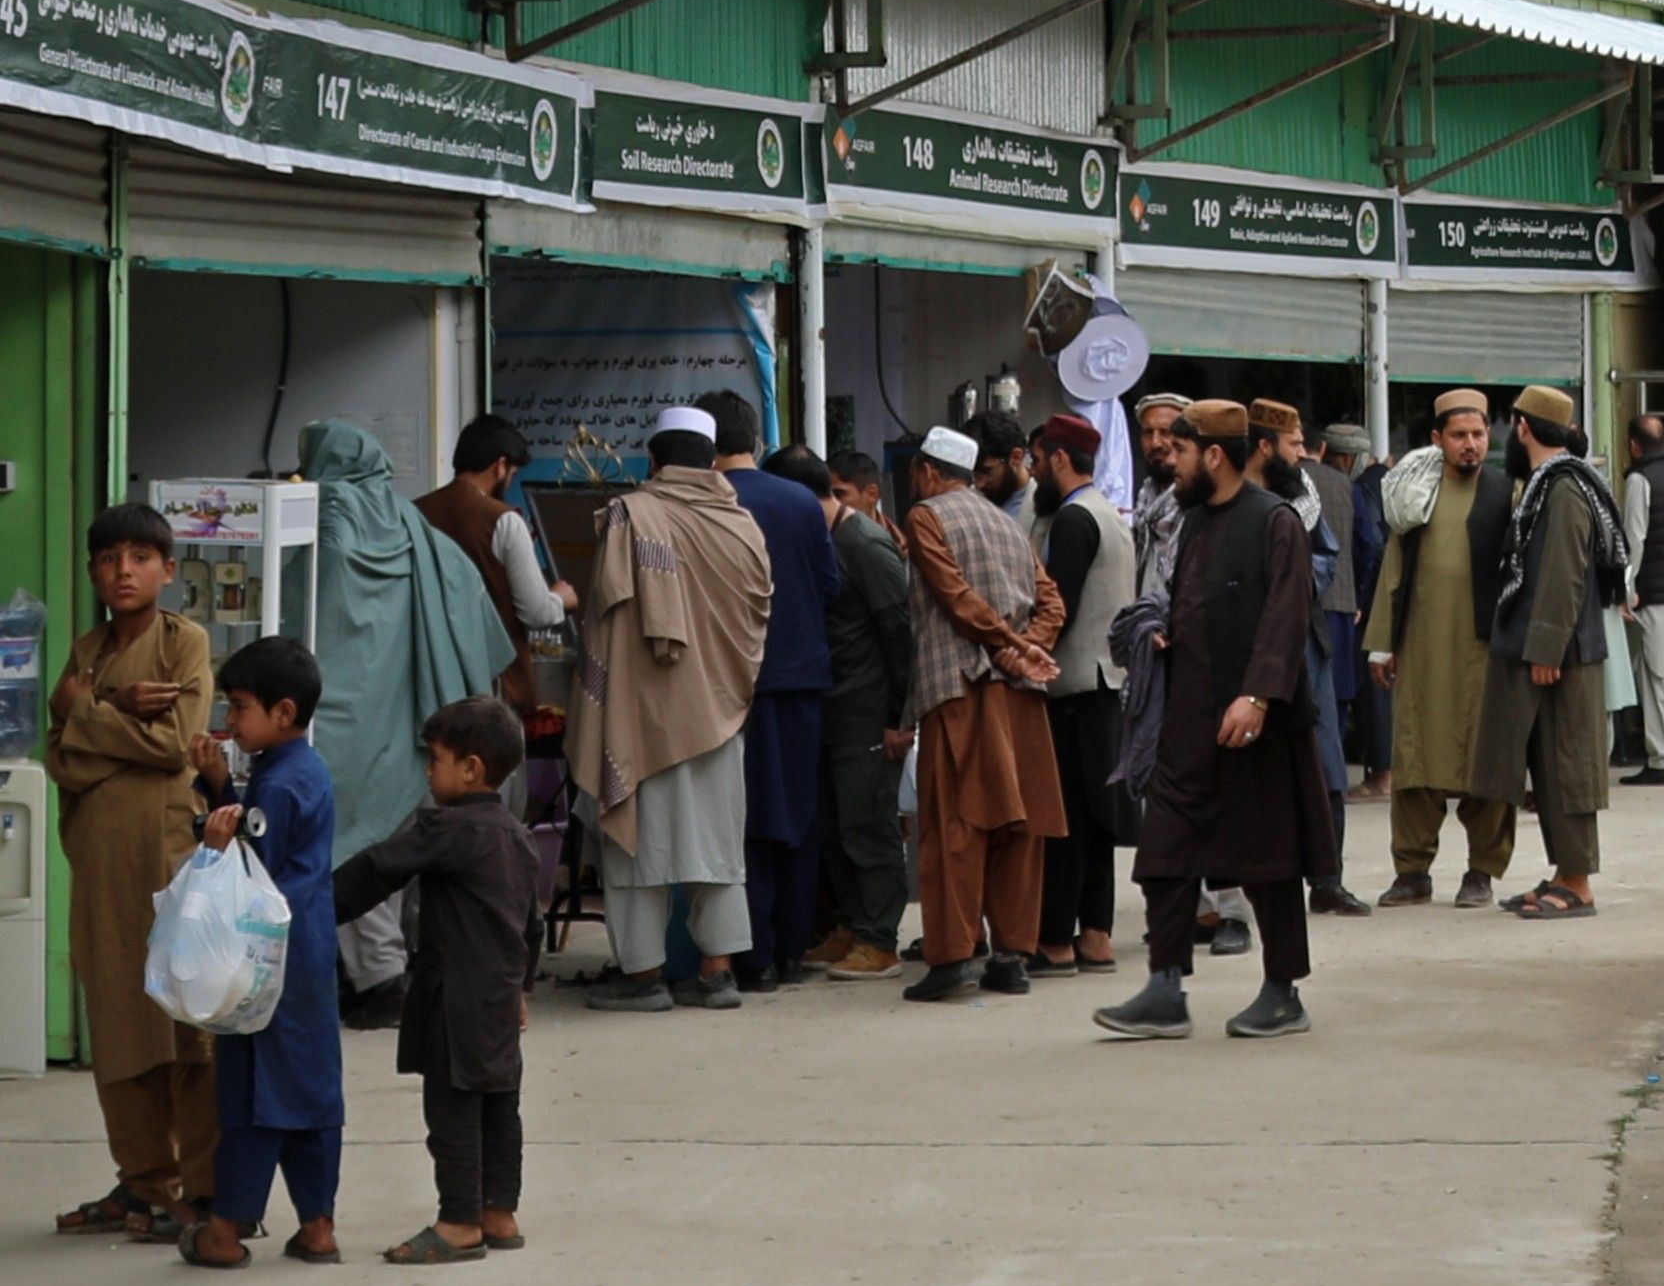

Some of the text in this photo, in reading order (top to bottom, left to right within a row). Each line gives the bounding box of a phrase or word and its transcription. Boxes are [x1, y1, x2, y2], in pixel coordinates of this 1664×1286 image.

[39, 42, 70, 70] General
[70, 50, 112, 81] Directorate
[112, 61, 122, 82] of
[122, 65, 155, 90] Livestock
[156, 76, 171, 96] and
[171, 78, 194, 104] Animal
[317, 73, 350, 121] 147
[358, 123, 401, 145] Directorate
[402, 130, 410, 148] of
[410, 131, 431, 151] Cereal
[431, 135, 444, 153] and
[445, 138, 476, 159] Industrial
[497, 146, 526, 167] Extension
[852, 138, 875, 154] AGFAIR
[903, 135, 935, 171] 148
[621, 149, 734, 179] Soil Research Directorate
[949, 169, 1069, 203] Animal Research Directorate
[1192, 198, 1221, 228] 149
[1271, 230, 1281, 242] and
[1299, 232, 1320, 246] Research
[1320, 234, 1349, 248] Directorate
[1438, 221, 1466, 247] 150
